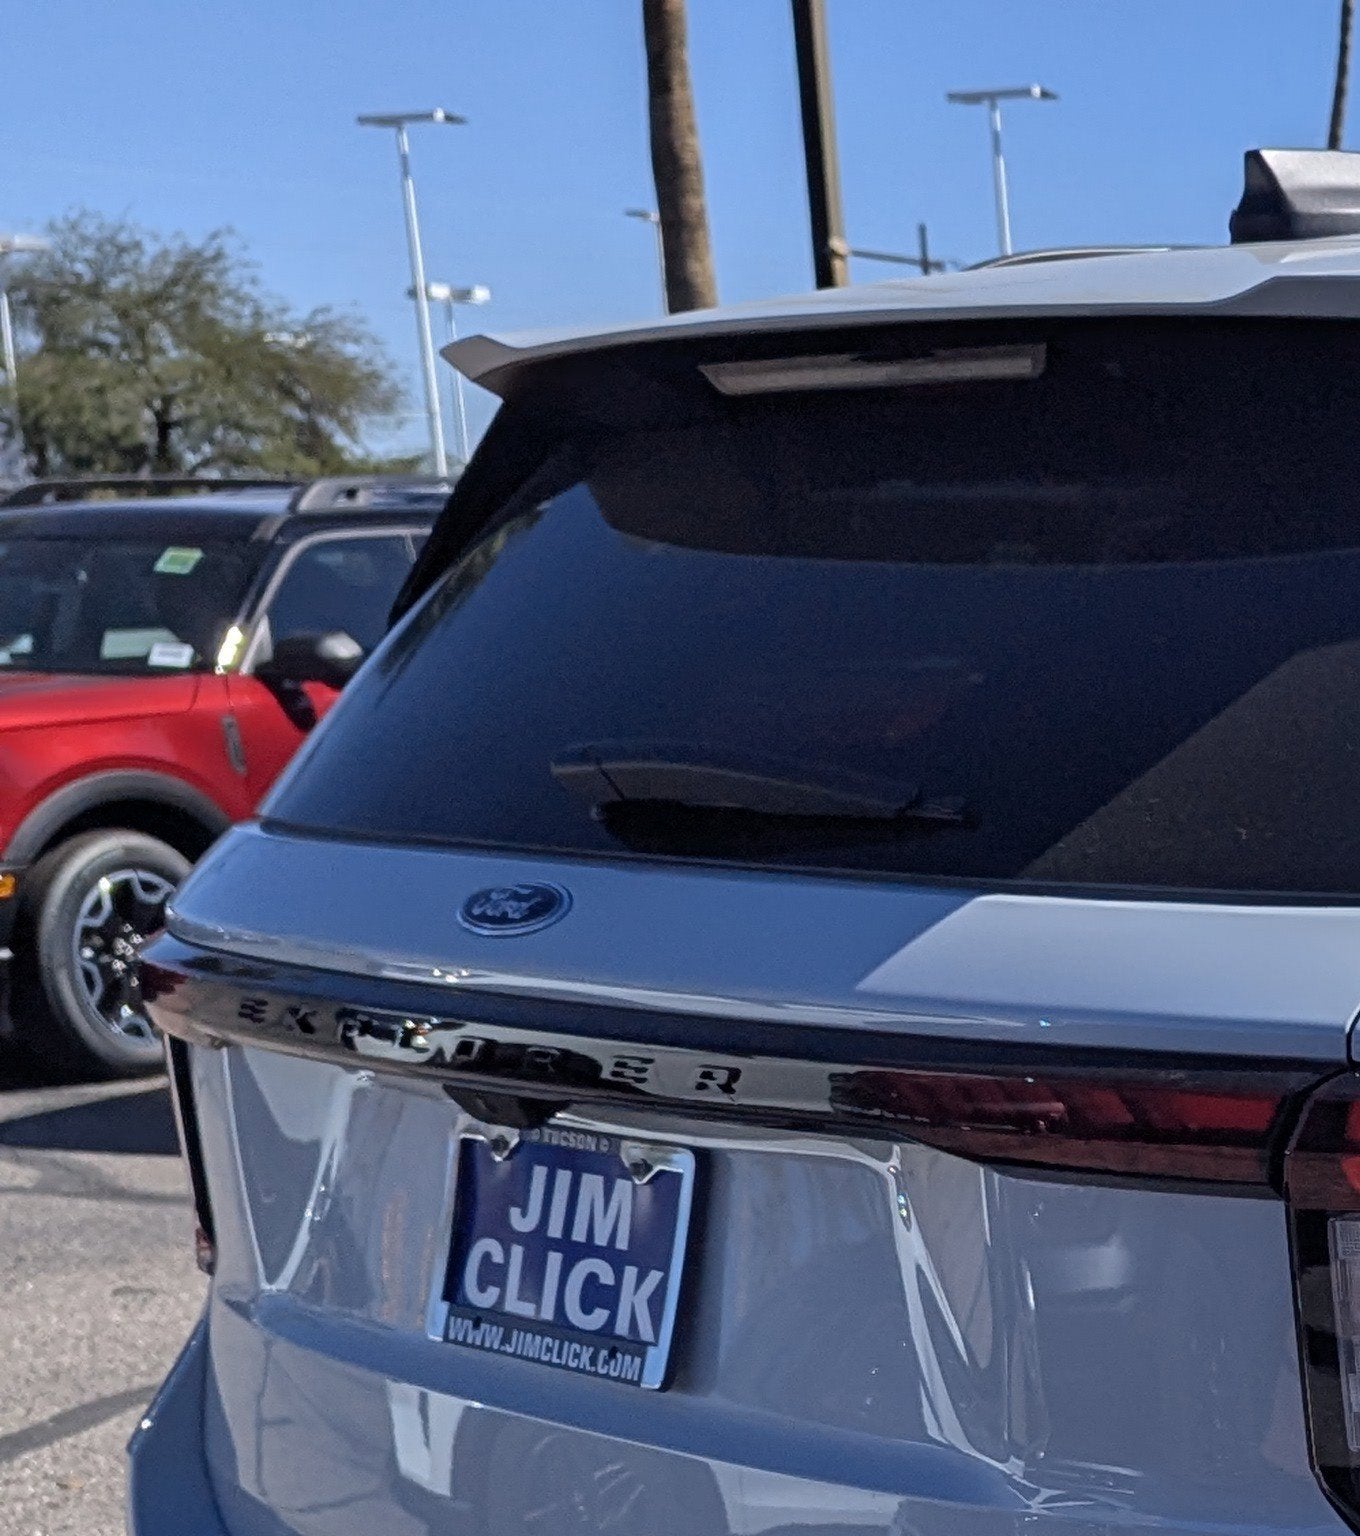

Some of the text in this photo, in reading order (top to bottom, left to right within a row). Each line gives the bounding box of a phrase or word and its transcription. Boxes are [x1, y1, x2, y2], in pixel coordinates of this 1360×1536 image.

[509, 1164, 633, 1251] JIM
[464, 1238, 665, 1343] CLICK
[448, 1315, 643, 1382] WWW.JIMCLICK.COM
